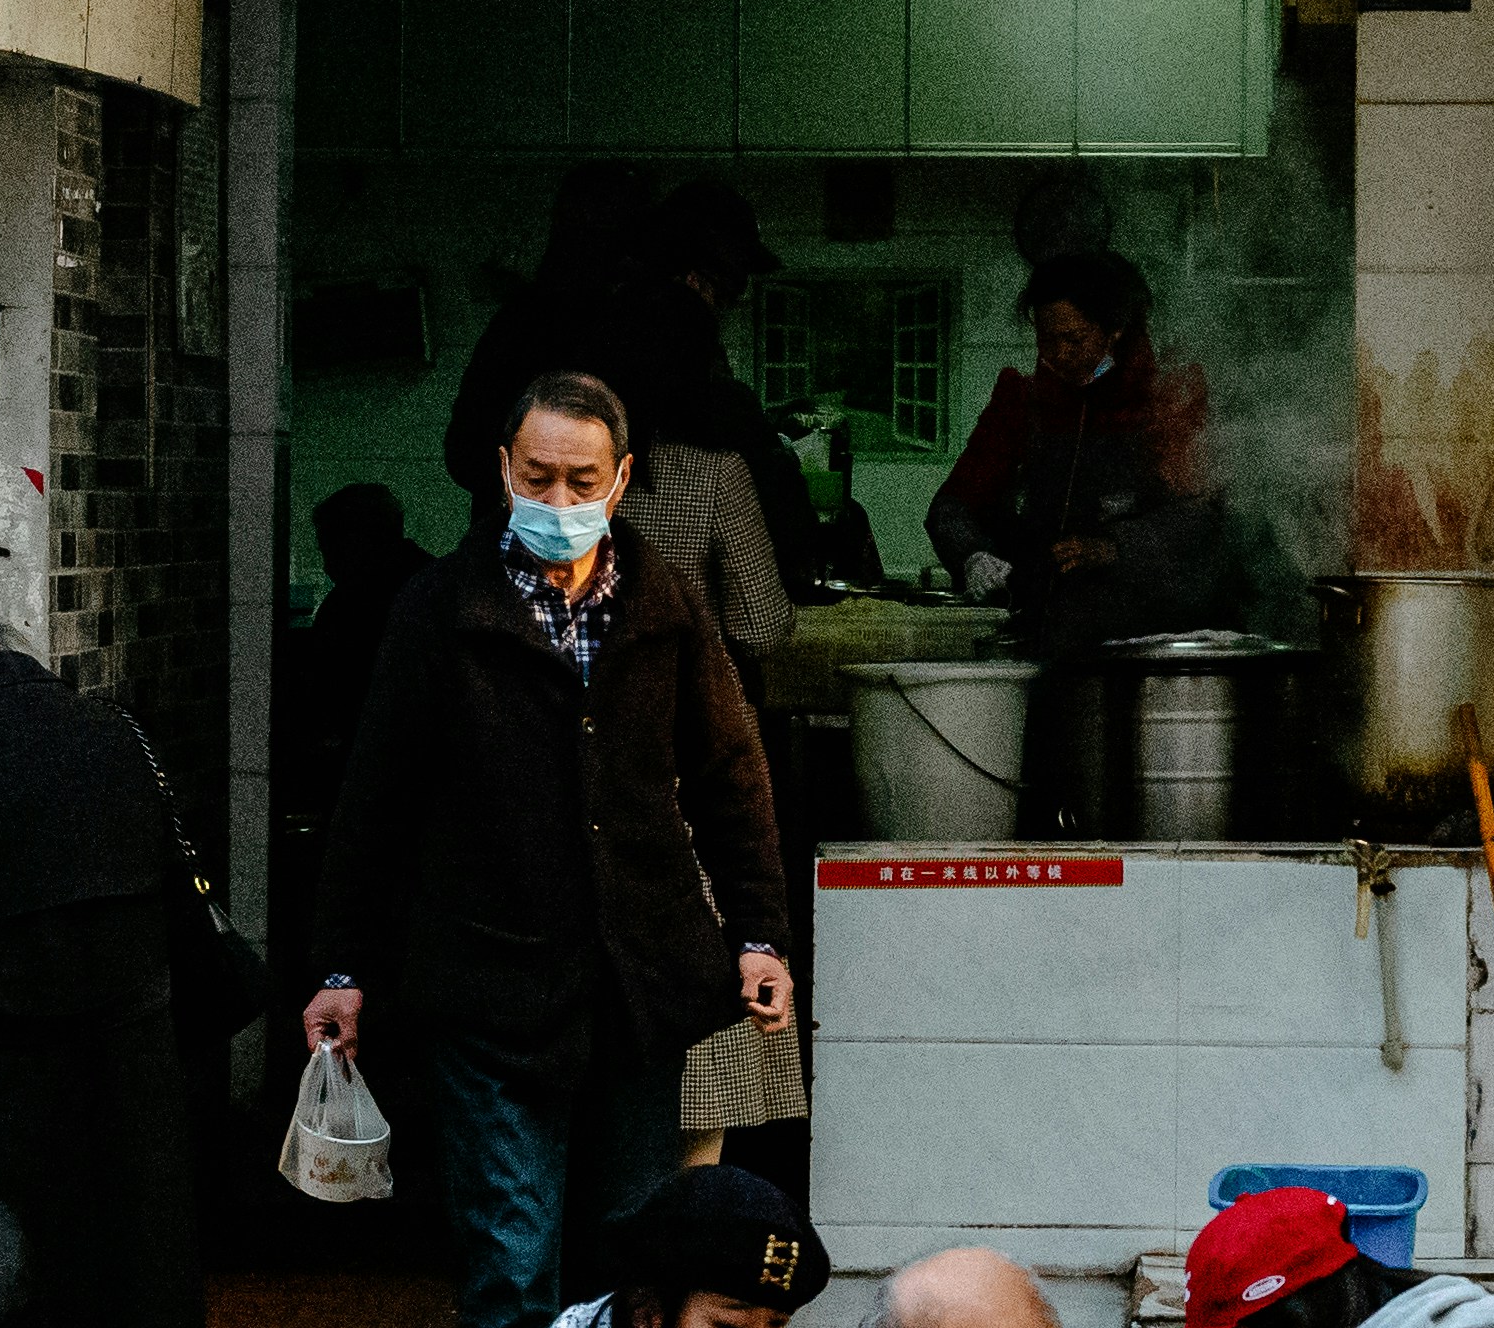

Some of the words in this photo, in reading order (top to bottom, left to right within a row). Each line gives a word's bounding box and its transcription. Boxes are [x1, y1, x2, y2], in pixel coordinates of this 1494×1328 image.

[878, 864, 1063, 882] 请在一米线以外等候
